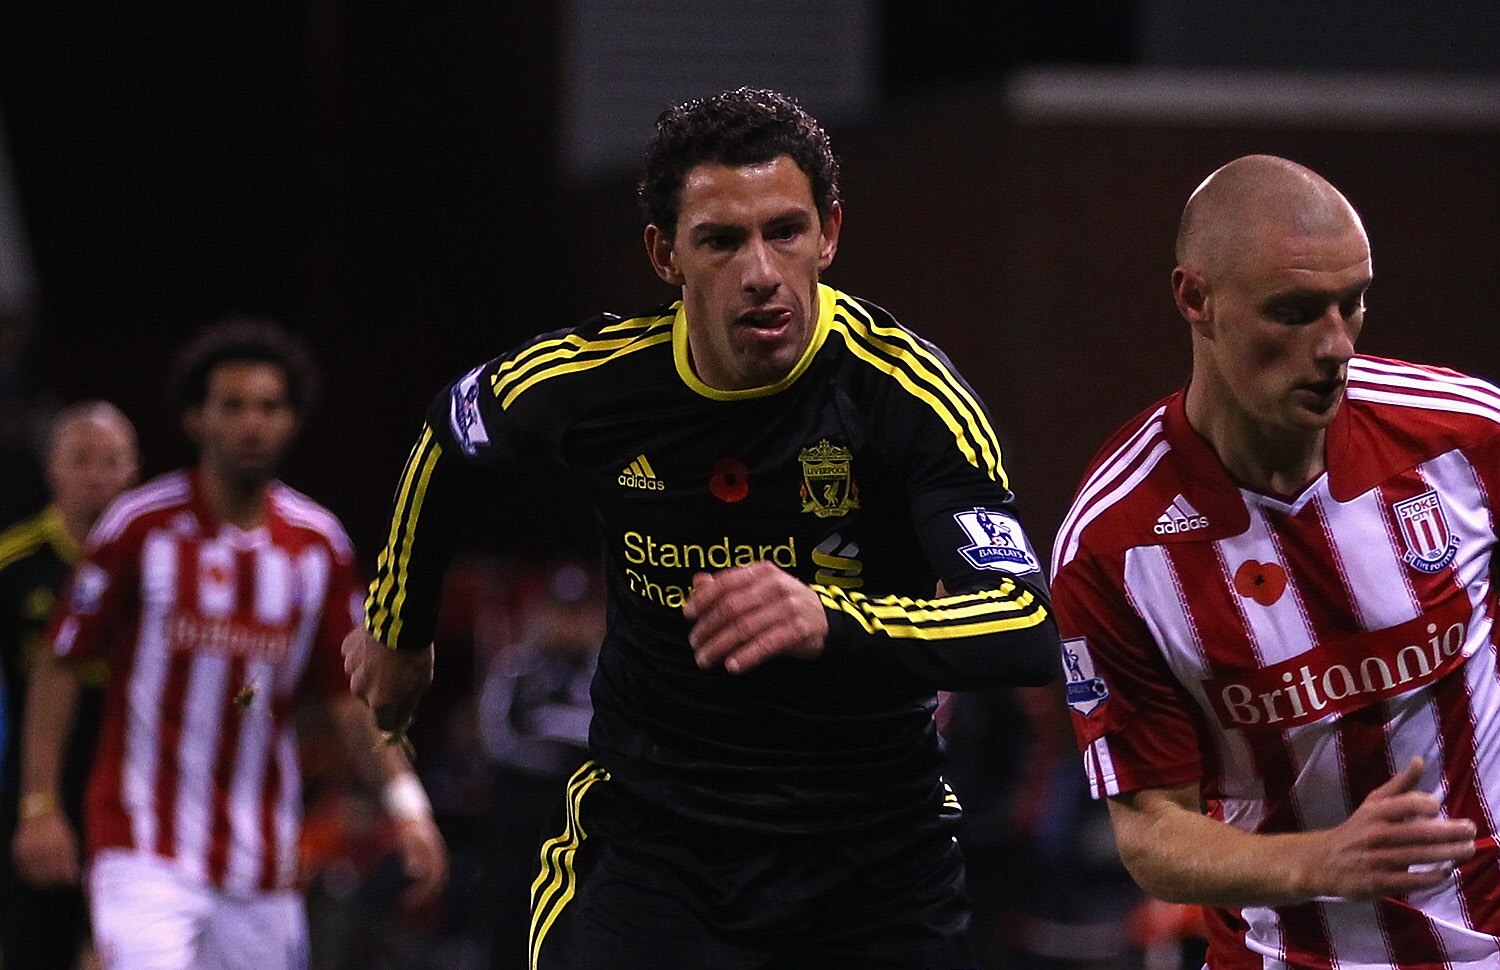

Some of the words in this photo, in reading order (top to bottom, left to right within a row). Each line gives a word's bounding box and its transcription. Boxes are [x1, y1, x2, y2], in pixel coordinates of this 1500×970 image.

[618, 474, 665, 490] adidas
[1400, 496, 1438, 518] STOKE
[1412, 510, 1430, 521] CITY
[1153, 516, 1209, 535] adidas
[624, 531, 797, 569] Standard
[978, 549, 1024, 559] BARCLAYS
[1221, 622, 1465, 725] Britannia
